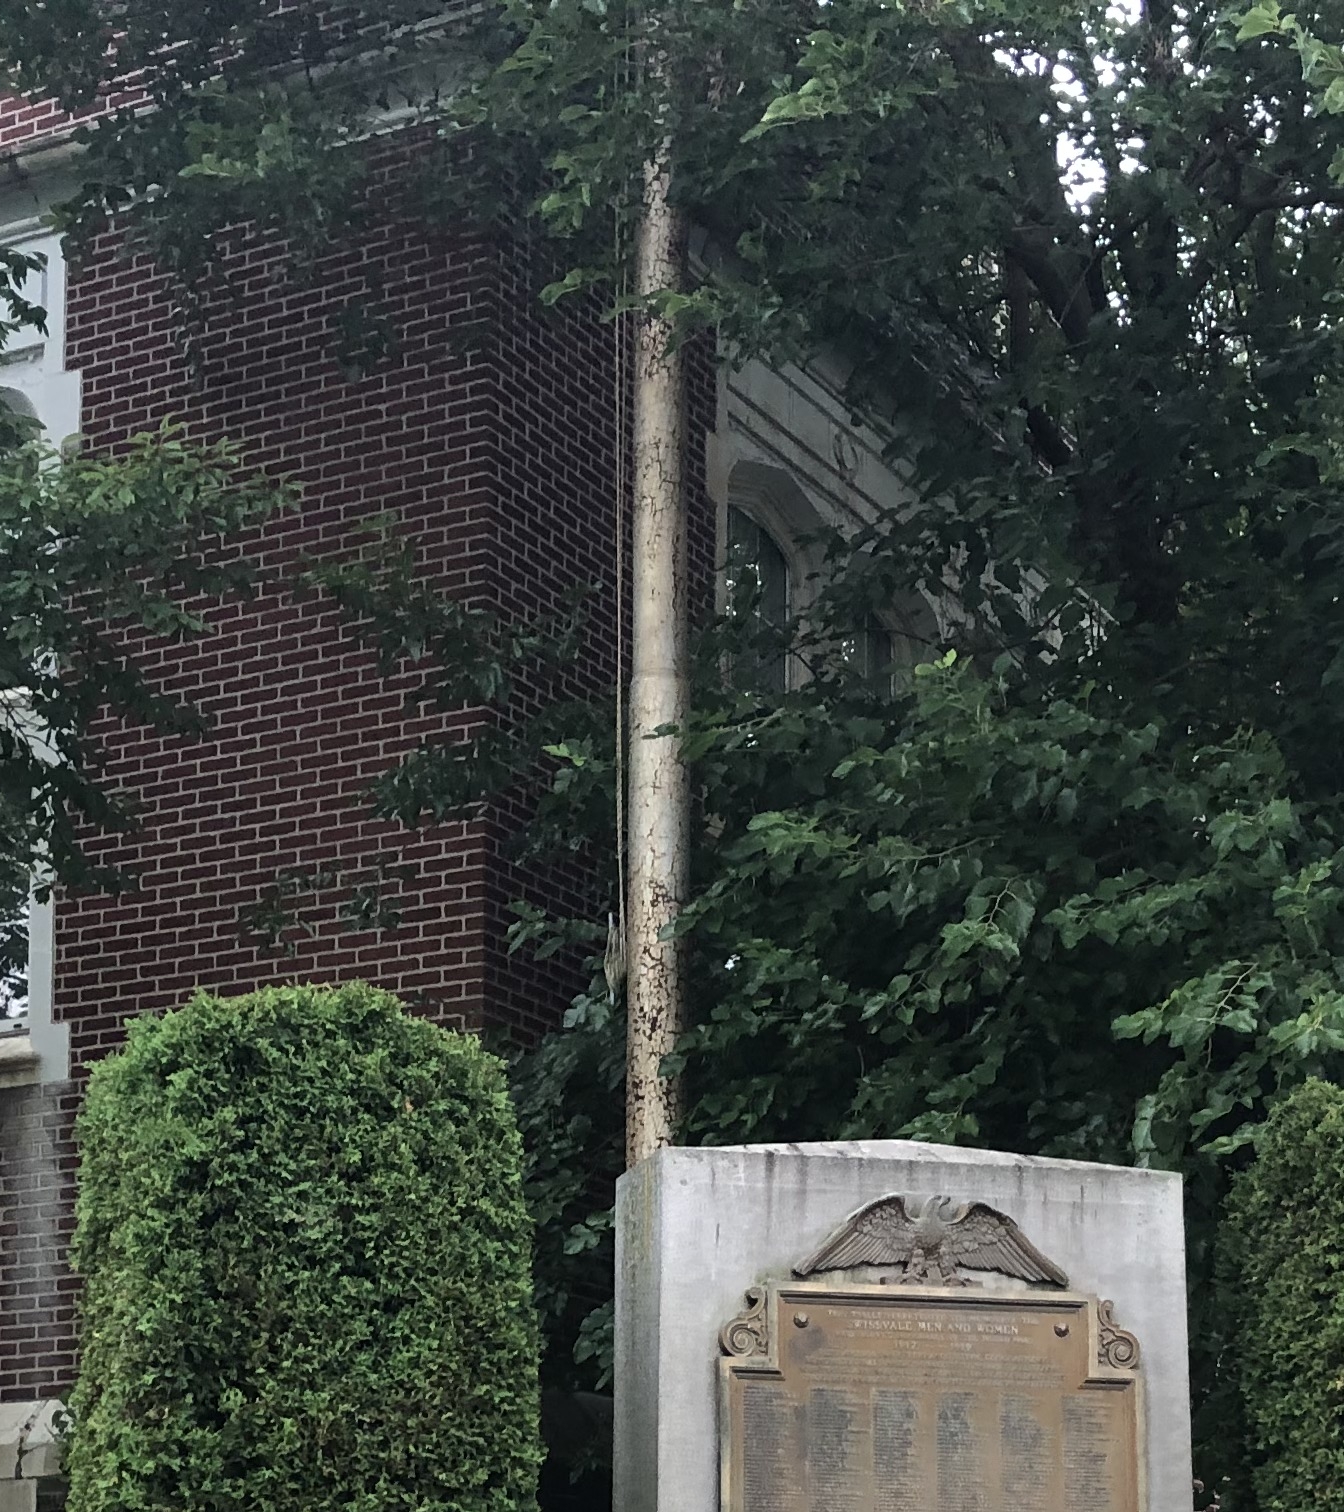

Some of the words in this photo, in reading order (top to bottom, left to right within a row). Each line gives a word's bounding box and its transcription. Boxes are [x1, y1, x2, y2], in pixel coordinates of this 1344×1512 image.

[917, 1321, 942, 1332] MEN
[947, 1323, 971, 1333] AND
[976, 1324, 1019, 1335] WOMEN
